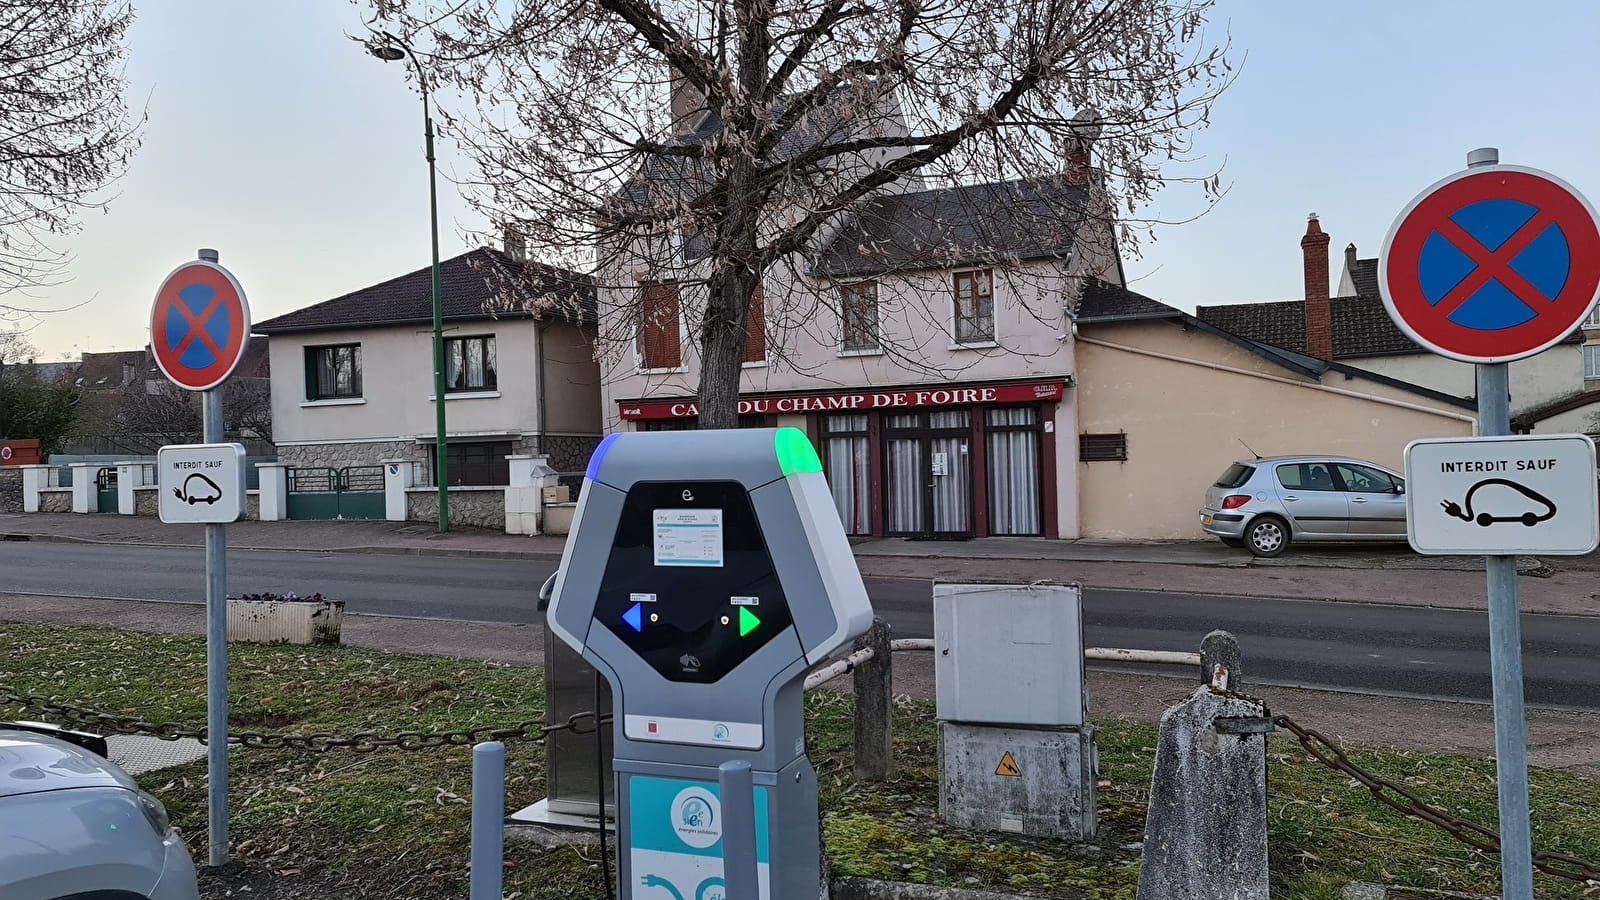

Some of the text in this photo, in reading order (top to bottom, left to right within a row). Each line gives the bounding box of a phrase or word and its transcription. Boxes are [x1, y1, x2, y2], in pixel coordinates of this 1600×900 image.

[738, 400, 770, 413] DU
[776, 395, 865, 411] CHAMP
[872, 393, 908, 407] DE
[915, 388, 997, 405] FOIRE
[173, 460, 223, 470] INTERDIT SAUF
[1441, 459, 1557, 473] INTERDIT SAUF
